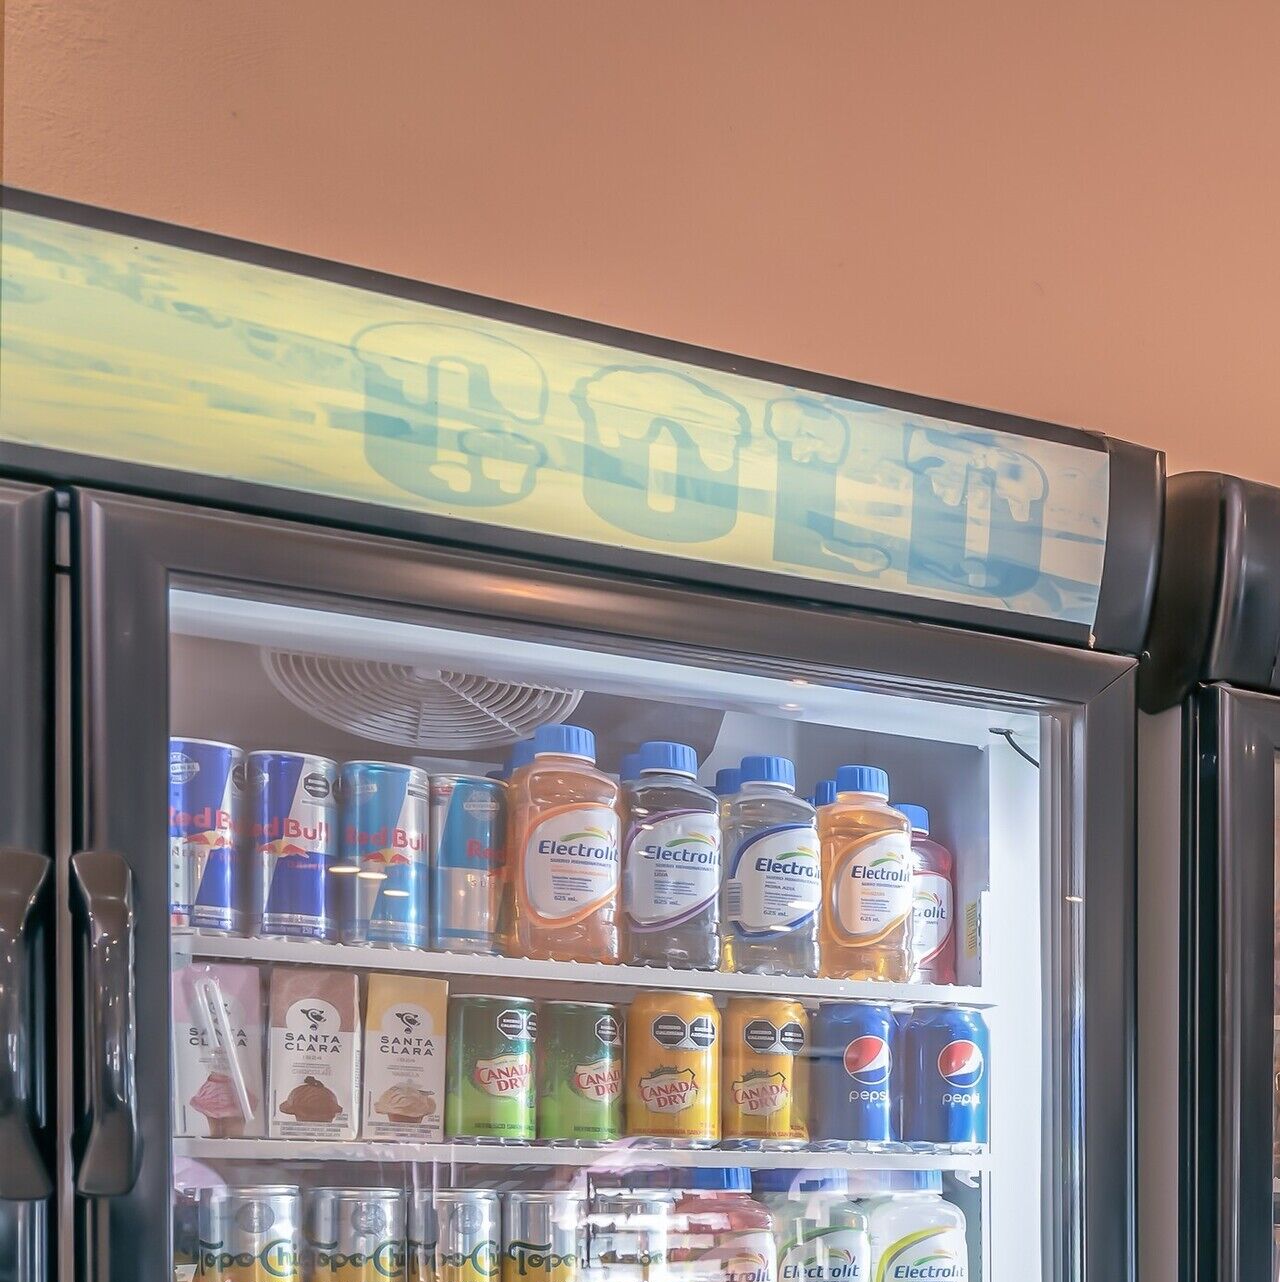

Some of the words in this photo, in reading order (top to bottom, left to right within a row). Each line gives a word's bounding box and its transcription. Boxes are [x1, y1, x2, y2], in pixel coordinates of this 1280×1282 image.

[351, 320, 1048, 598] COLD
[392, 829, 428, 851] Bull
[538, 839, 619, 863] Electrolit
[644, 845, 721, 866] Electrolit
[284, 1033, 340, 1044] SANTA
[380, 1036, 434, 1047] SANTA
[284, 1042, 341, 1053] CLARA
[380, 1045, 435, 1056] CLARA
[496, 1077, 527, 1092] DRY
[639, 1081, 699, 1102] CANADA
[656, 1092, 688, 1109] DRY
[733, 1083, 789, 1105] CANADA
[783, 1264, 860, 1280] Electrolit
[894, 1264, 966, 1280] Electrolit
